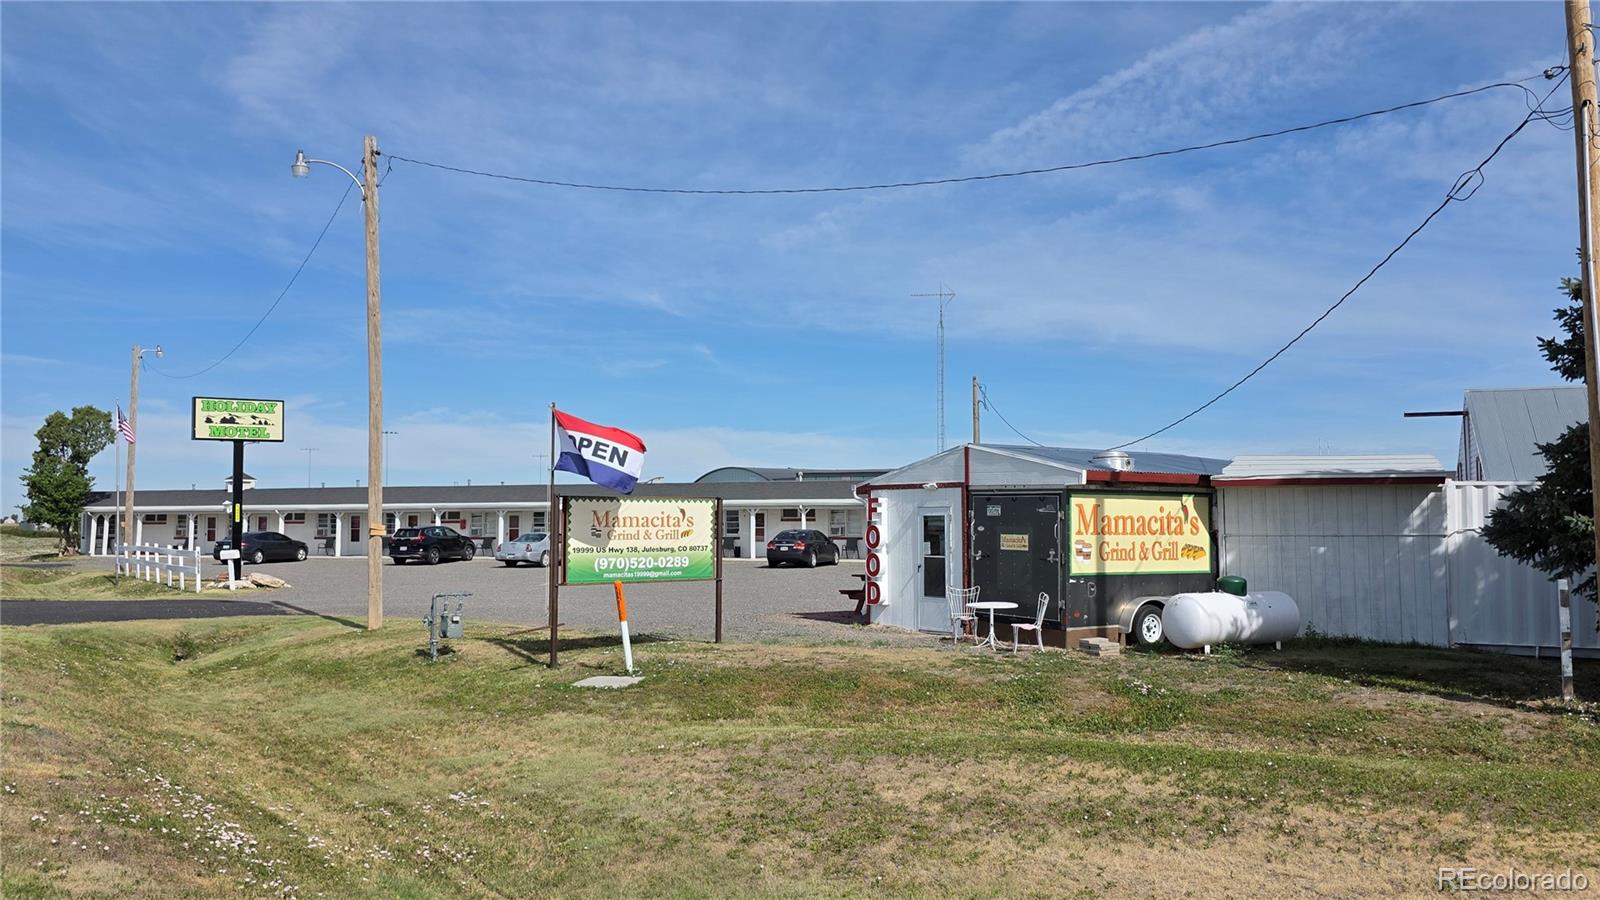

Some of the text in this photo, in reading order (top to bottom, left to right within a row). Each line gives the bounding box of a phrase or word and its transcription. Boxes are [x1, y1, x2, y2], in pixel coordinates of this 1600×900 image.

[201, 400, 278, 414] HOLIDAY
[209, 425, 270, 438] MOTEL
[592, 507, 694, 528] Mamacita's
[1074, 502, 1200, 536] Mamacita's
[607, 528, 680, 541] Grind & Grill
[595, 546, 607, 554] US
[608, 546, 624, 555] Hwy
[641, 545, 676, 553] Julesburg,
[1099, 540, 1179, 562] Grind & Grill
[594, 556, 689, 572] (970)520-0289
